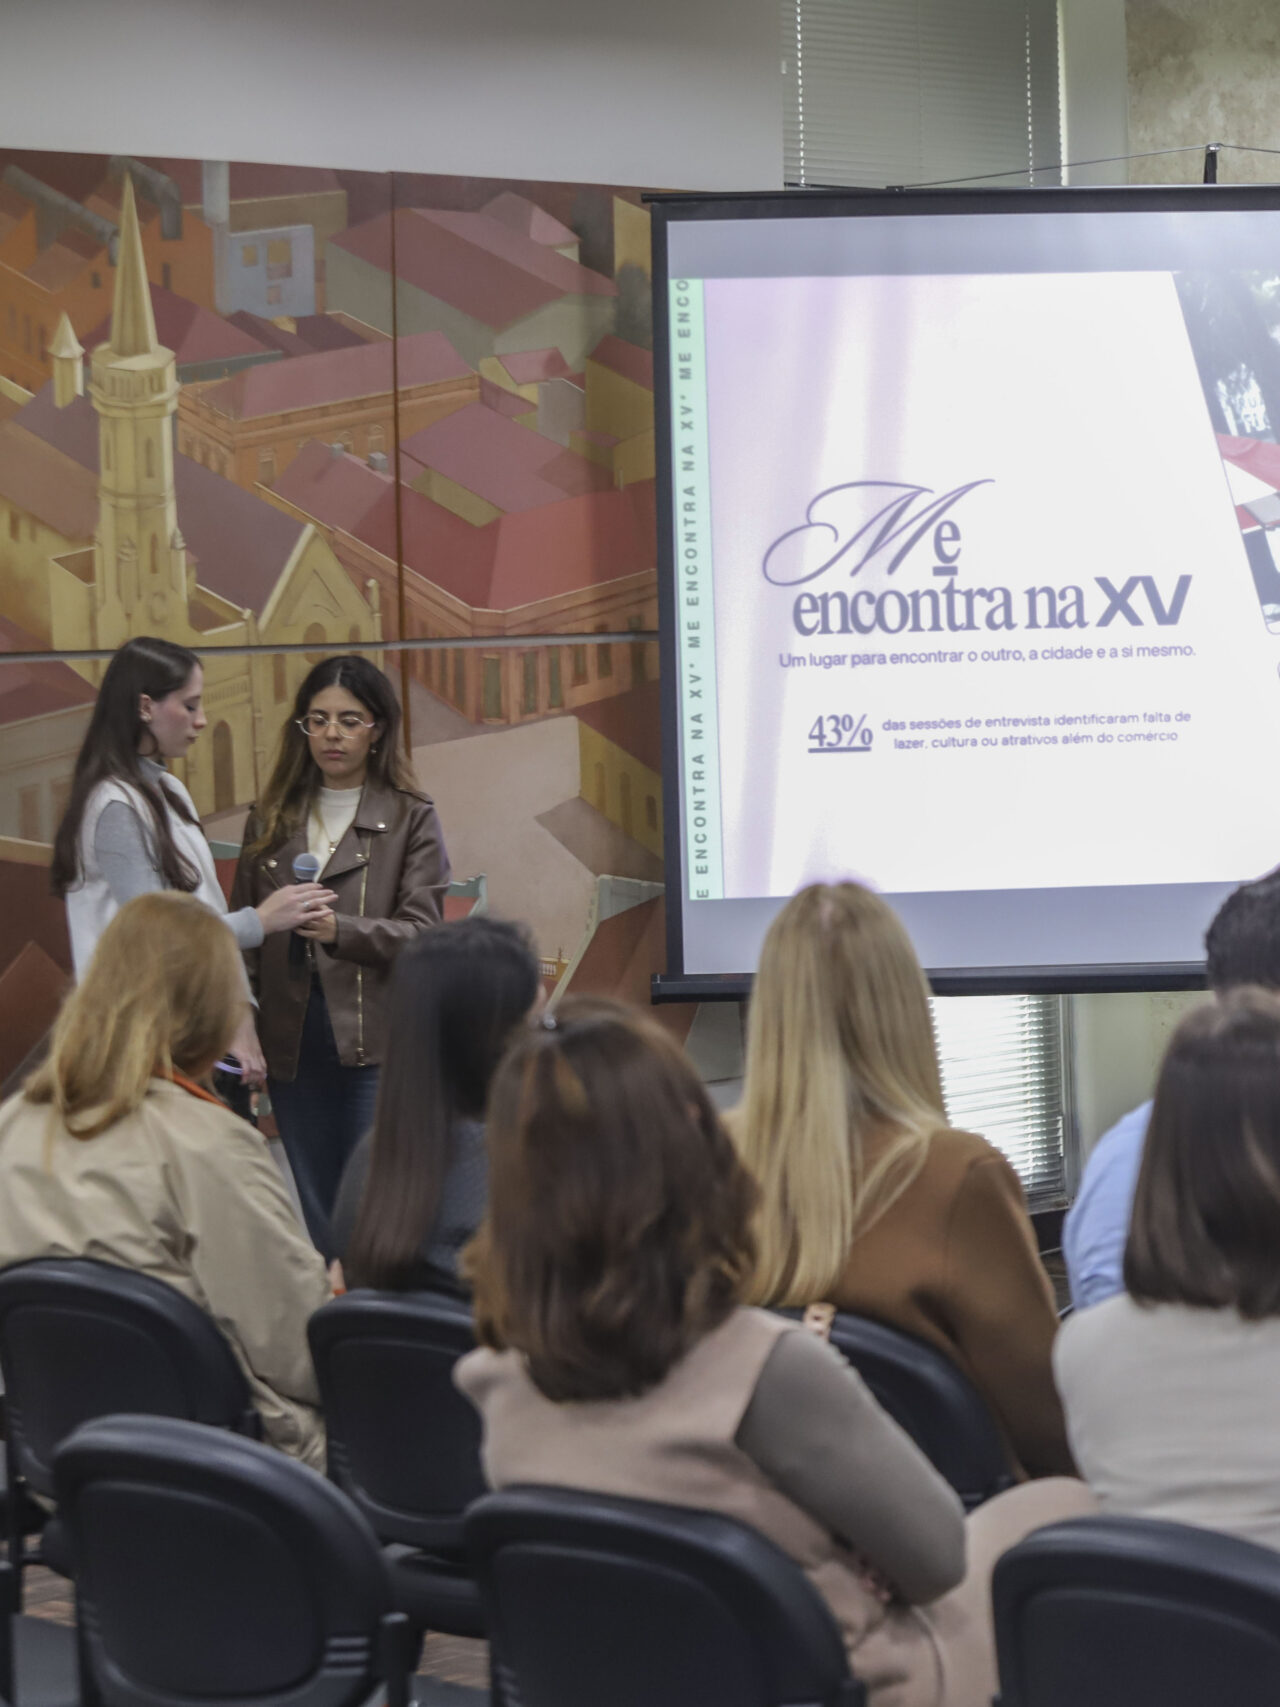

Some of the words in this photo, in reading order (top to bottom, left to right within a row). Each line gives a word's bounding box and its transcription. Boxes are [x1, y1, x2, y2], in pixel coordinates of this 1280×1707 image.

[676, 279, 692, 338] ENCO
[678, 353, 692, 380] ME
[681, 445, 695, 471] NA
[762, 478, 996, 587] Me
[682, 486, 700, 607] ENCONTRA
[792, 576, 1018, 637] encontra
[1023, 585, 1090, 630] na
[1093, 574, 1193, 627] XV
[687, 621, 701, 648] ME
[778, 652, 807, 668] Um
[809, 652, 848, 669] lugar
[850, 653, 888, 668] para
[889, 650, 964, 665] encontrar
[967, 650, 978, 663] o
[981, 648, 1026, 662] outro,
[1028, 648, 1038, 661] a
[1041, 646, 1094, 660] cidade
[1096, 647, 1106, 659] e
[1109, 646, 1119, 659] a
[1121, 645, 1134, 658] si
[1136, 645, 1196, 658] mesmo.
[690, 713, 704, 739] NA
[808, 713, 873, 747] 43%
[882, 719, 906, 731] das
[909, 717, 961, 730] sessões
[965, 717, 982, 729] de
[985, 714, 1051, 728] entrevista
[1054, 713, 1139, 726] identificaram
[1143, 711, 1171, 724] falta
[1174, 711, 1192, 723] de
[893, 738, 928, 750] lazer,
[931, 736, 978, 748] cultura
[981, 739, 999, 747] ou
[1001, 735, 1059, 746] atrativos
[1061, 732, 1094, 744] além
[1096, 732, 1114, 743] do
[691, 753, 709, 874] ENCONTRA
